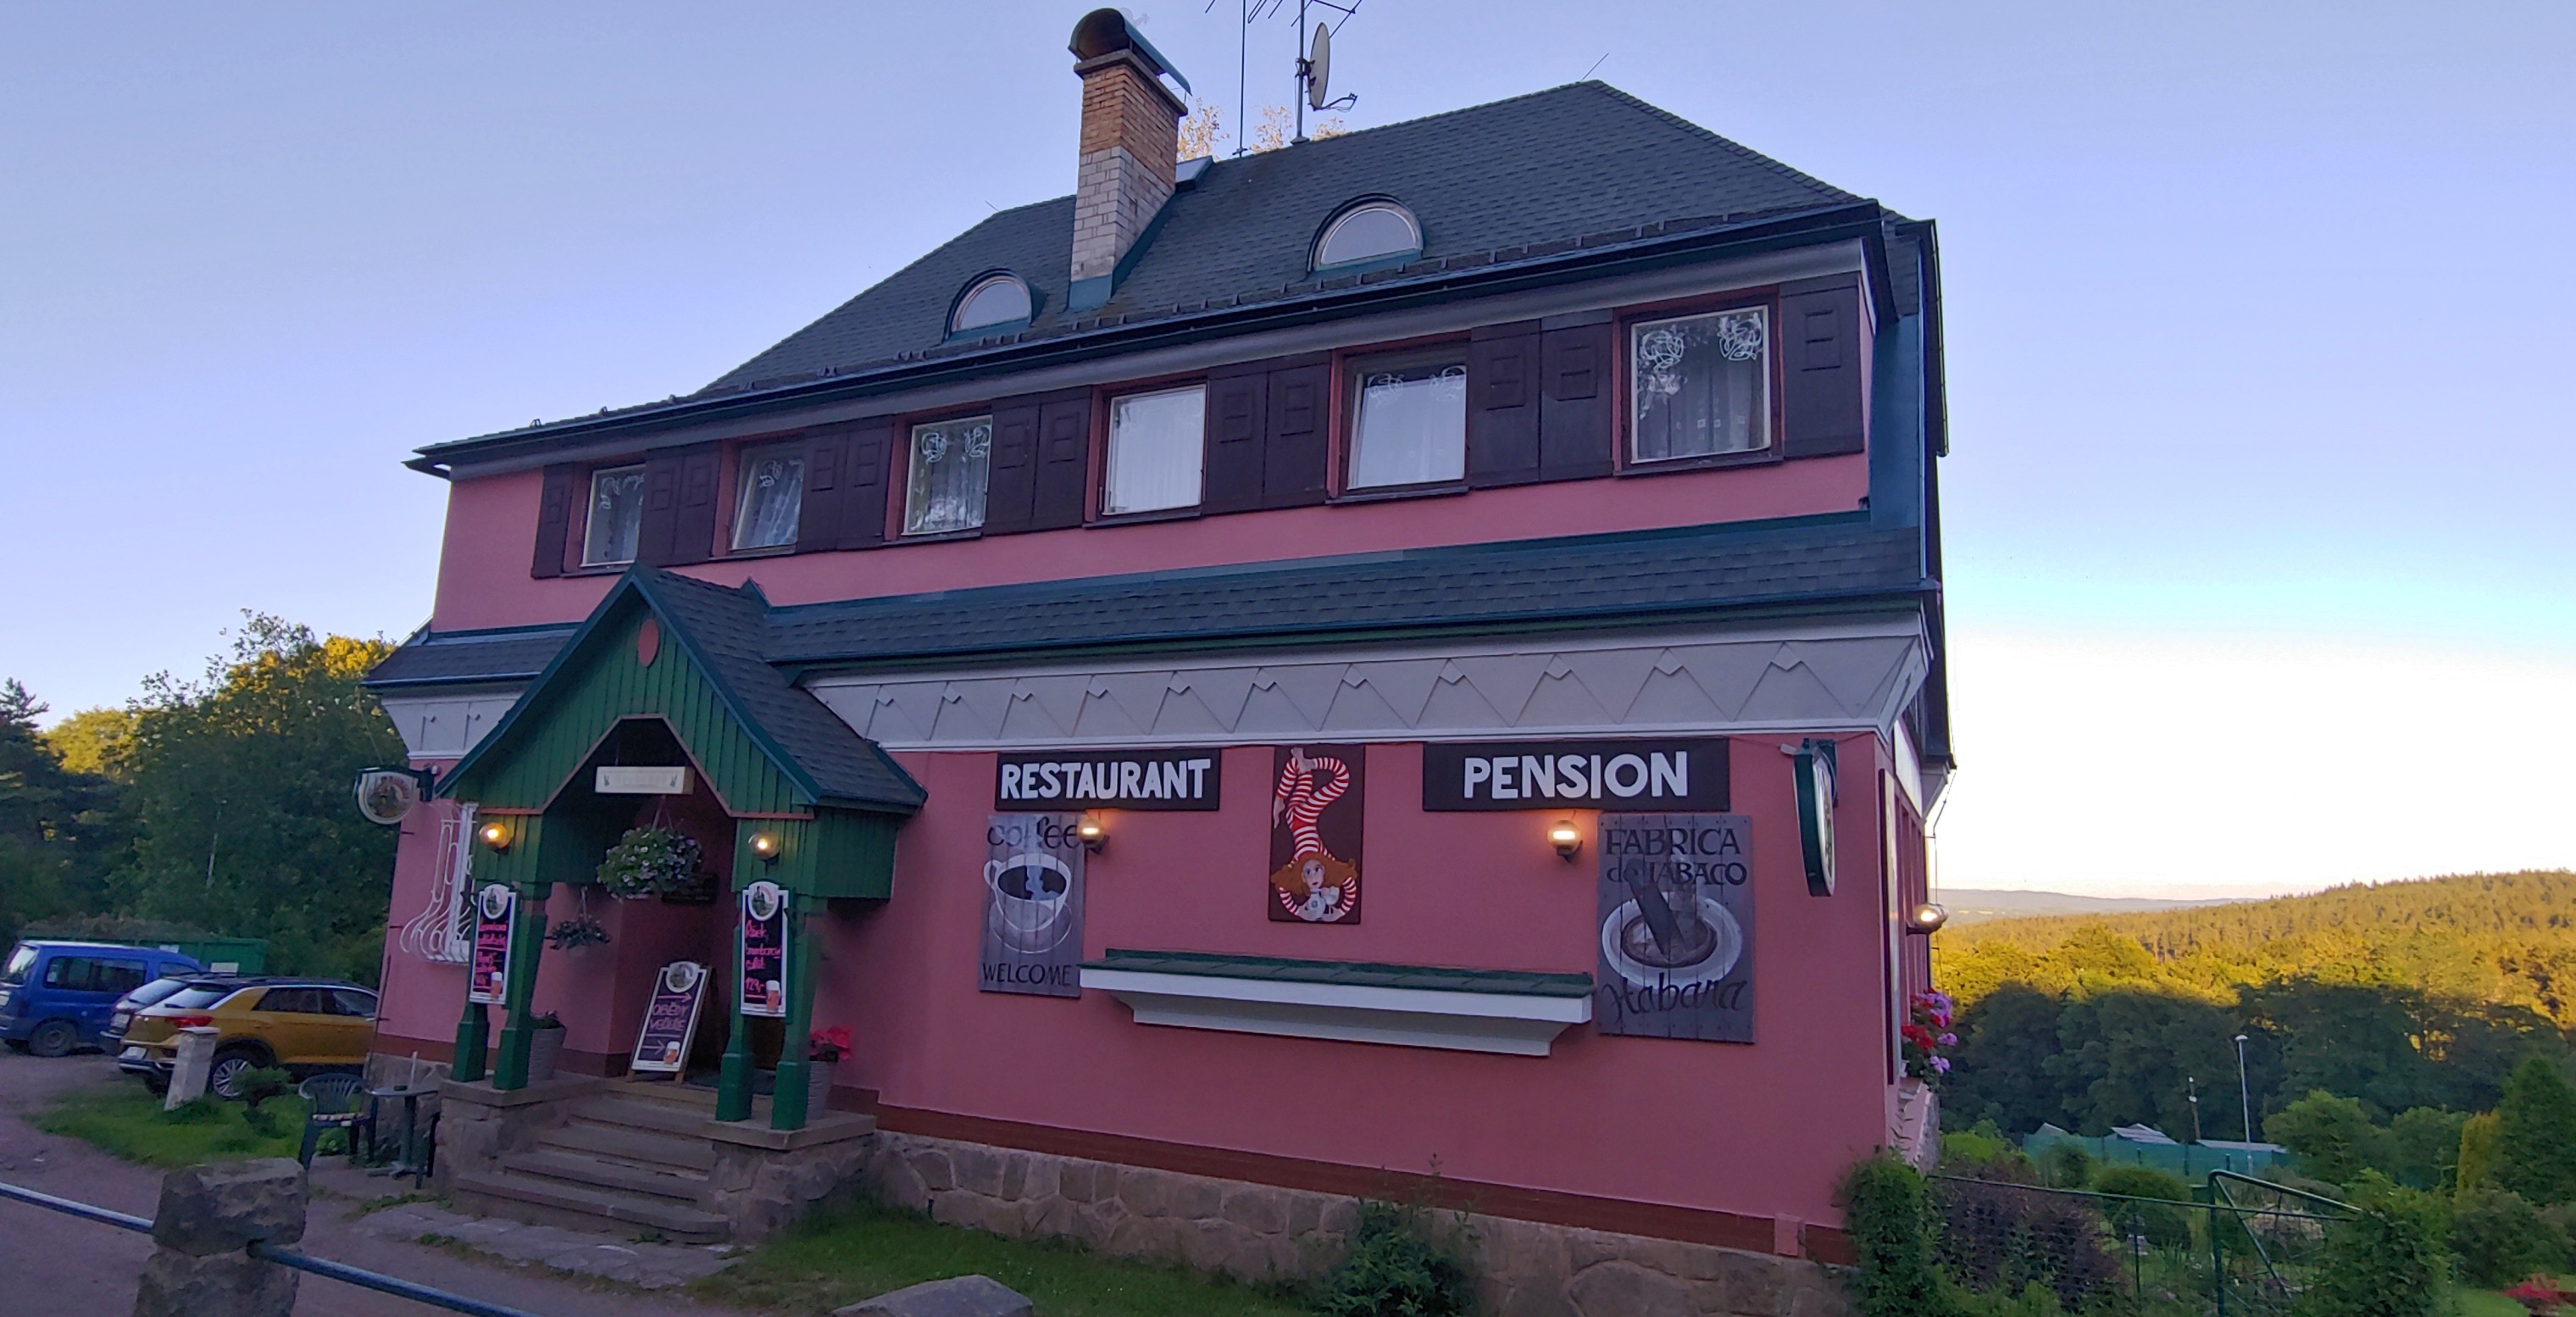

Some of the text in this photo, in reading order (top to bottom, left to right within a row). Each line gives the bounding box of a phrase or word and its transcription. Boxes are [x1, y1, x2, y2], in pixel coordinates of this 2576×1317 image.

[1001, 759, 1211, 799] RESTAURANT
[1463, 751, 1688, 799] PENSION
[1605, 828, 1741, 855] FABRICA
[1646, 861, 1747, 886] TABACO
[983, 963, 1072, 986] WELCOME
